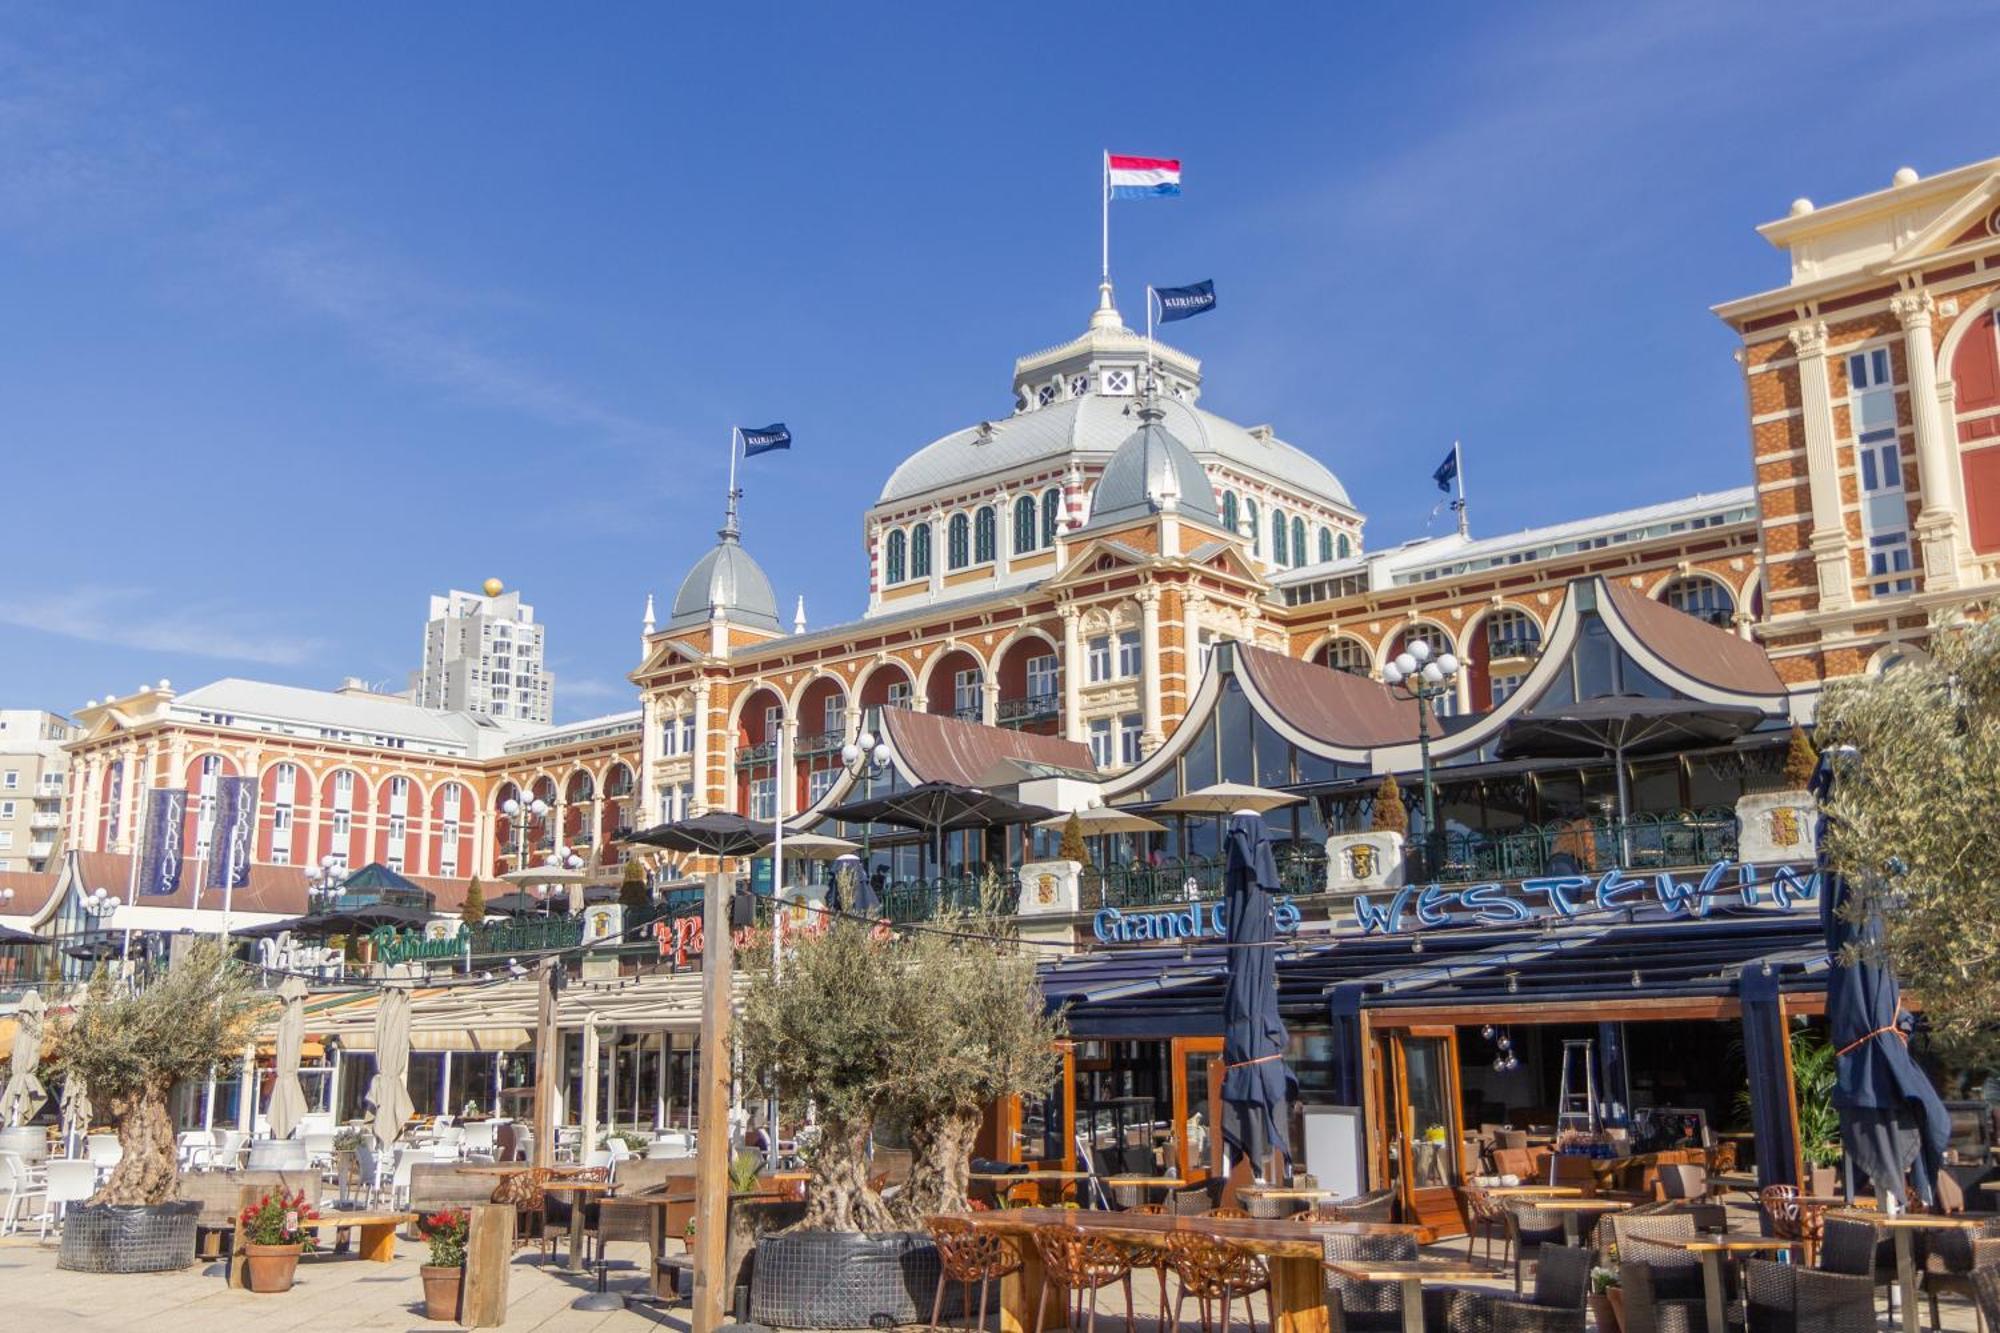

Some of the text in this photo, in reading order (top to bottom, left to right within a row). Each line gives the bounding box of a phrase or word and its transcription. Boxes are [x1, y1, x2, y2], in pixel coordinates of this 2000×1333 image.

[1164, 293, 1214, 307] KURHAUS
[161, 794, 180, 891] KURHAUS
[1093, 896, 1301, 943] Grand Cé
[1353, 860, 1824, 934] WESTEWIN
